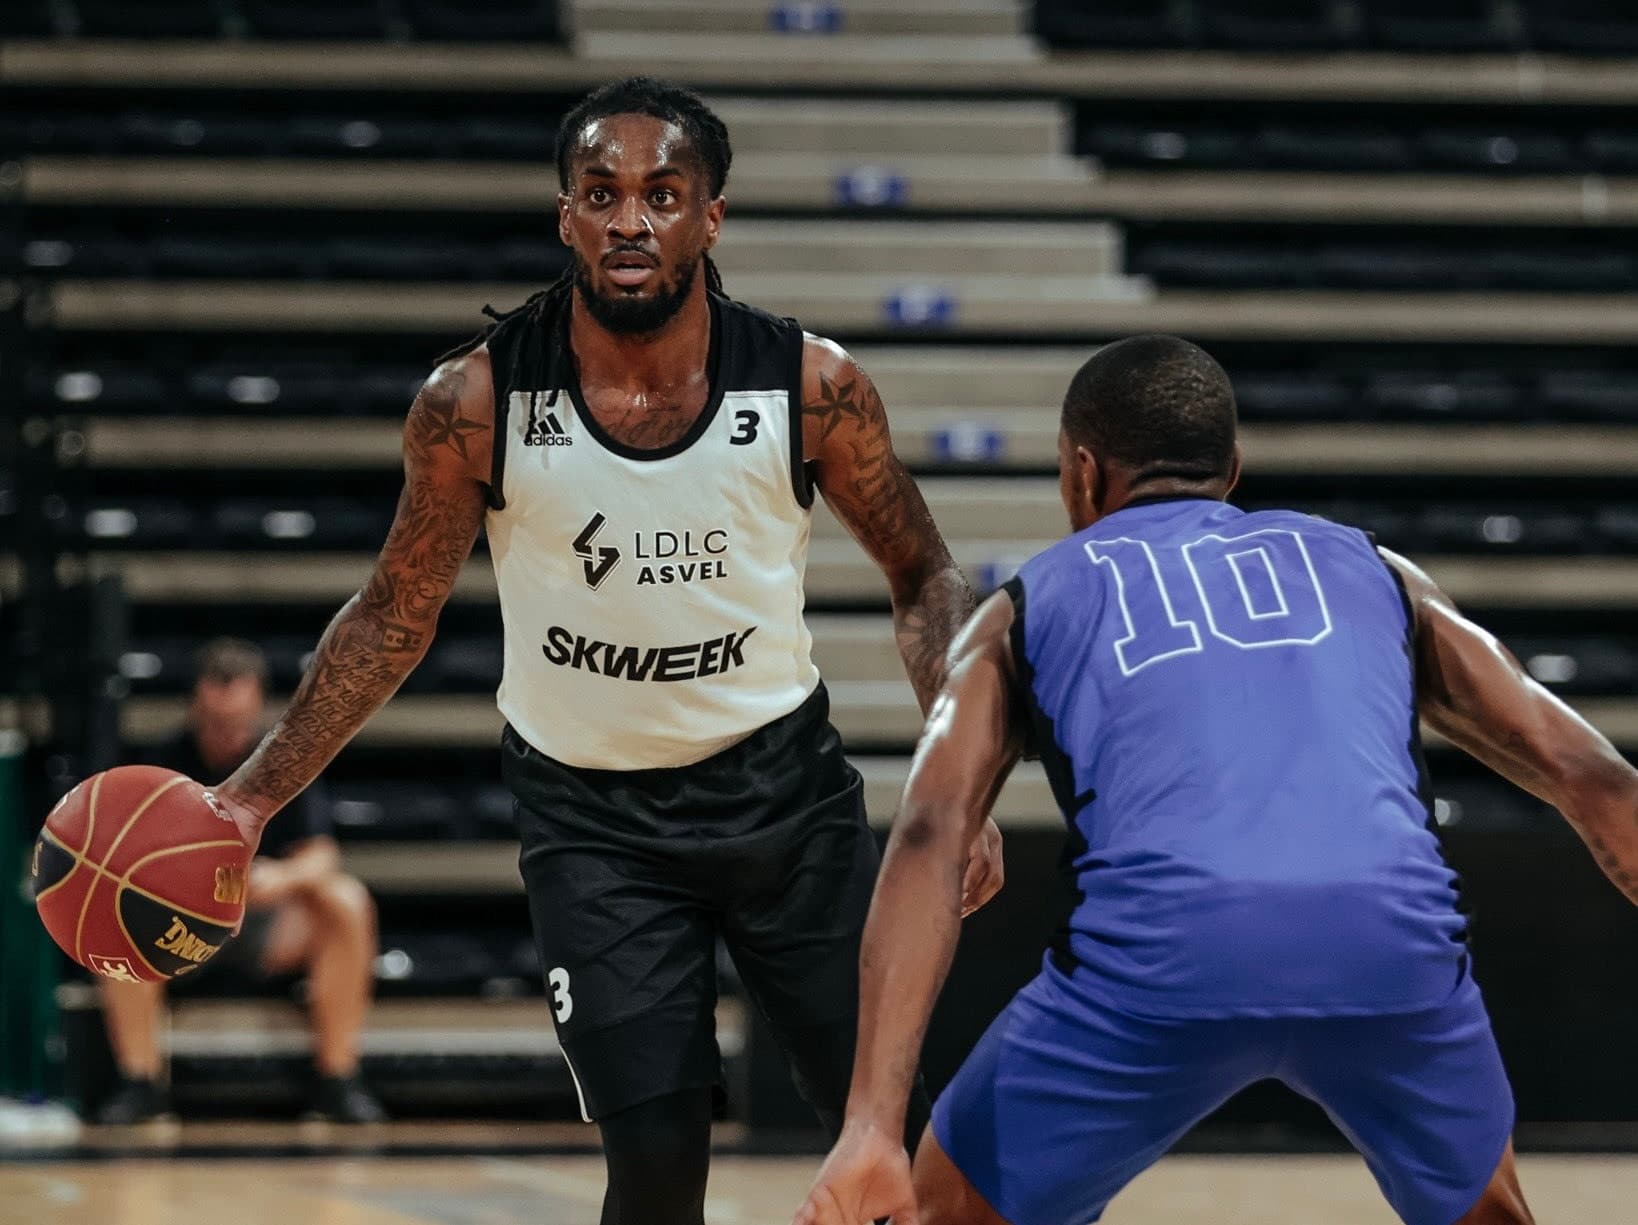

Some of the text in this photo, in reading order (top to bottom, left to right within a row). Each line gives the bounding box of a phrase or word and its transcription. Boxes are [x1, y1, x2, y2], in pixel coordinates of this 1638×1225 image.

[523, 432, 573, 447] adidas
[730, 410, 761, 445] 3
[635, 530, 728, 559] LDLC
[636, 560, 728, 585] ASVEL
[1084, 528, 1333, 677] 10
[542, 626, 758, 682] SKWEEK
[548, 967, 573, 1024] 3
